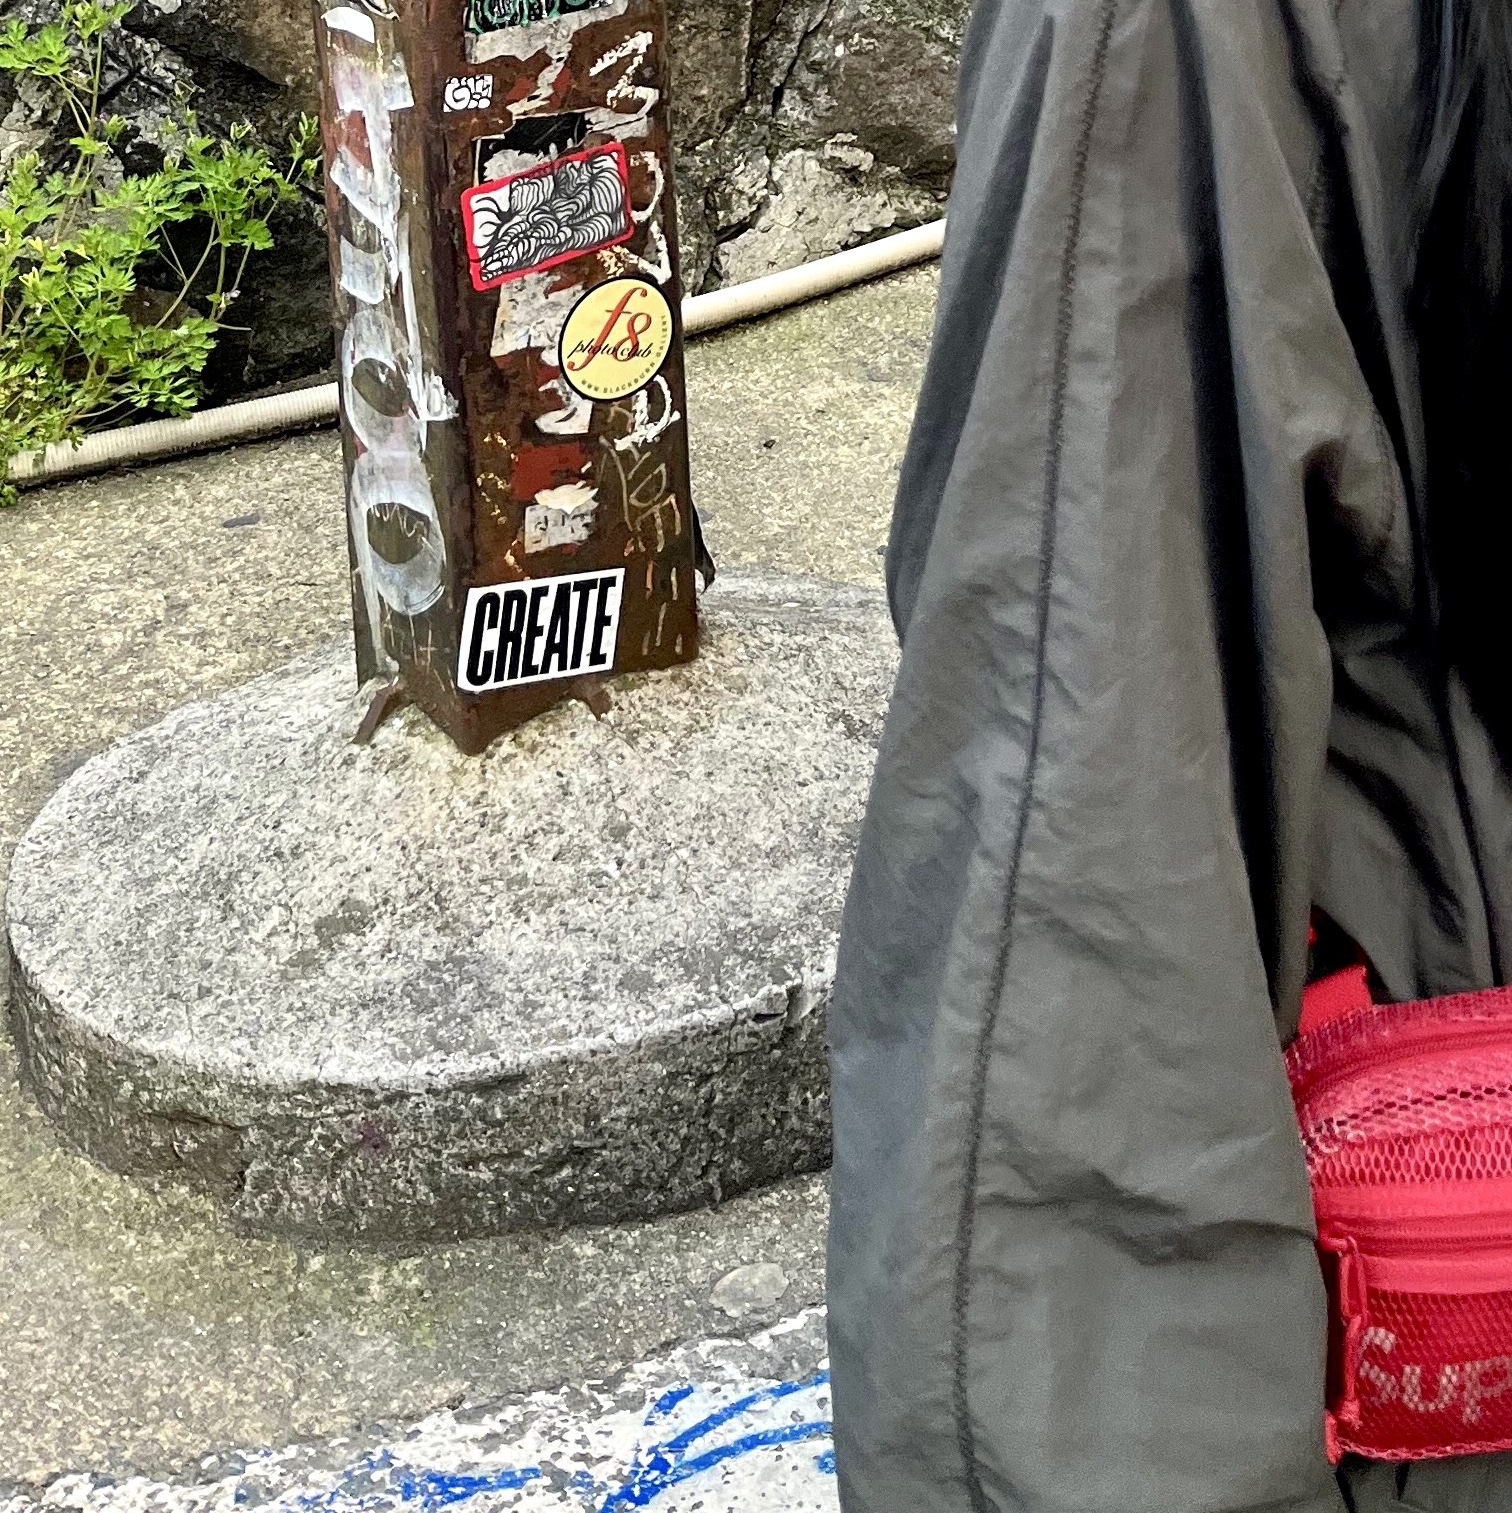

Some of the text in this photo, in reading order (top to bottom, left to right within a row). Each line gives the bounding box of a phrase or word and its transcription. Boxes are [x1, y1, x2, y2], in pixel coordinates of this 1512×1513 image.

[567, 287, 652, 372] f8
[567, 338, 654, 360] photo club
[465, 575, 617, 687] CREATE
